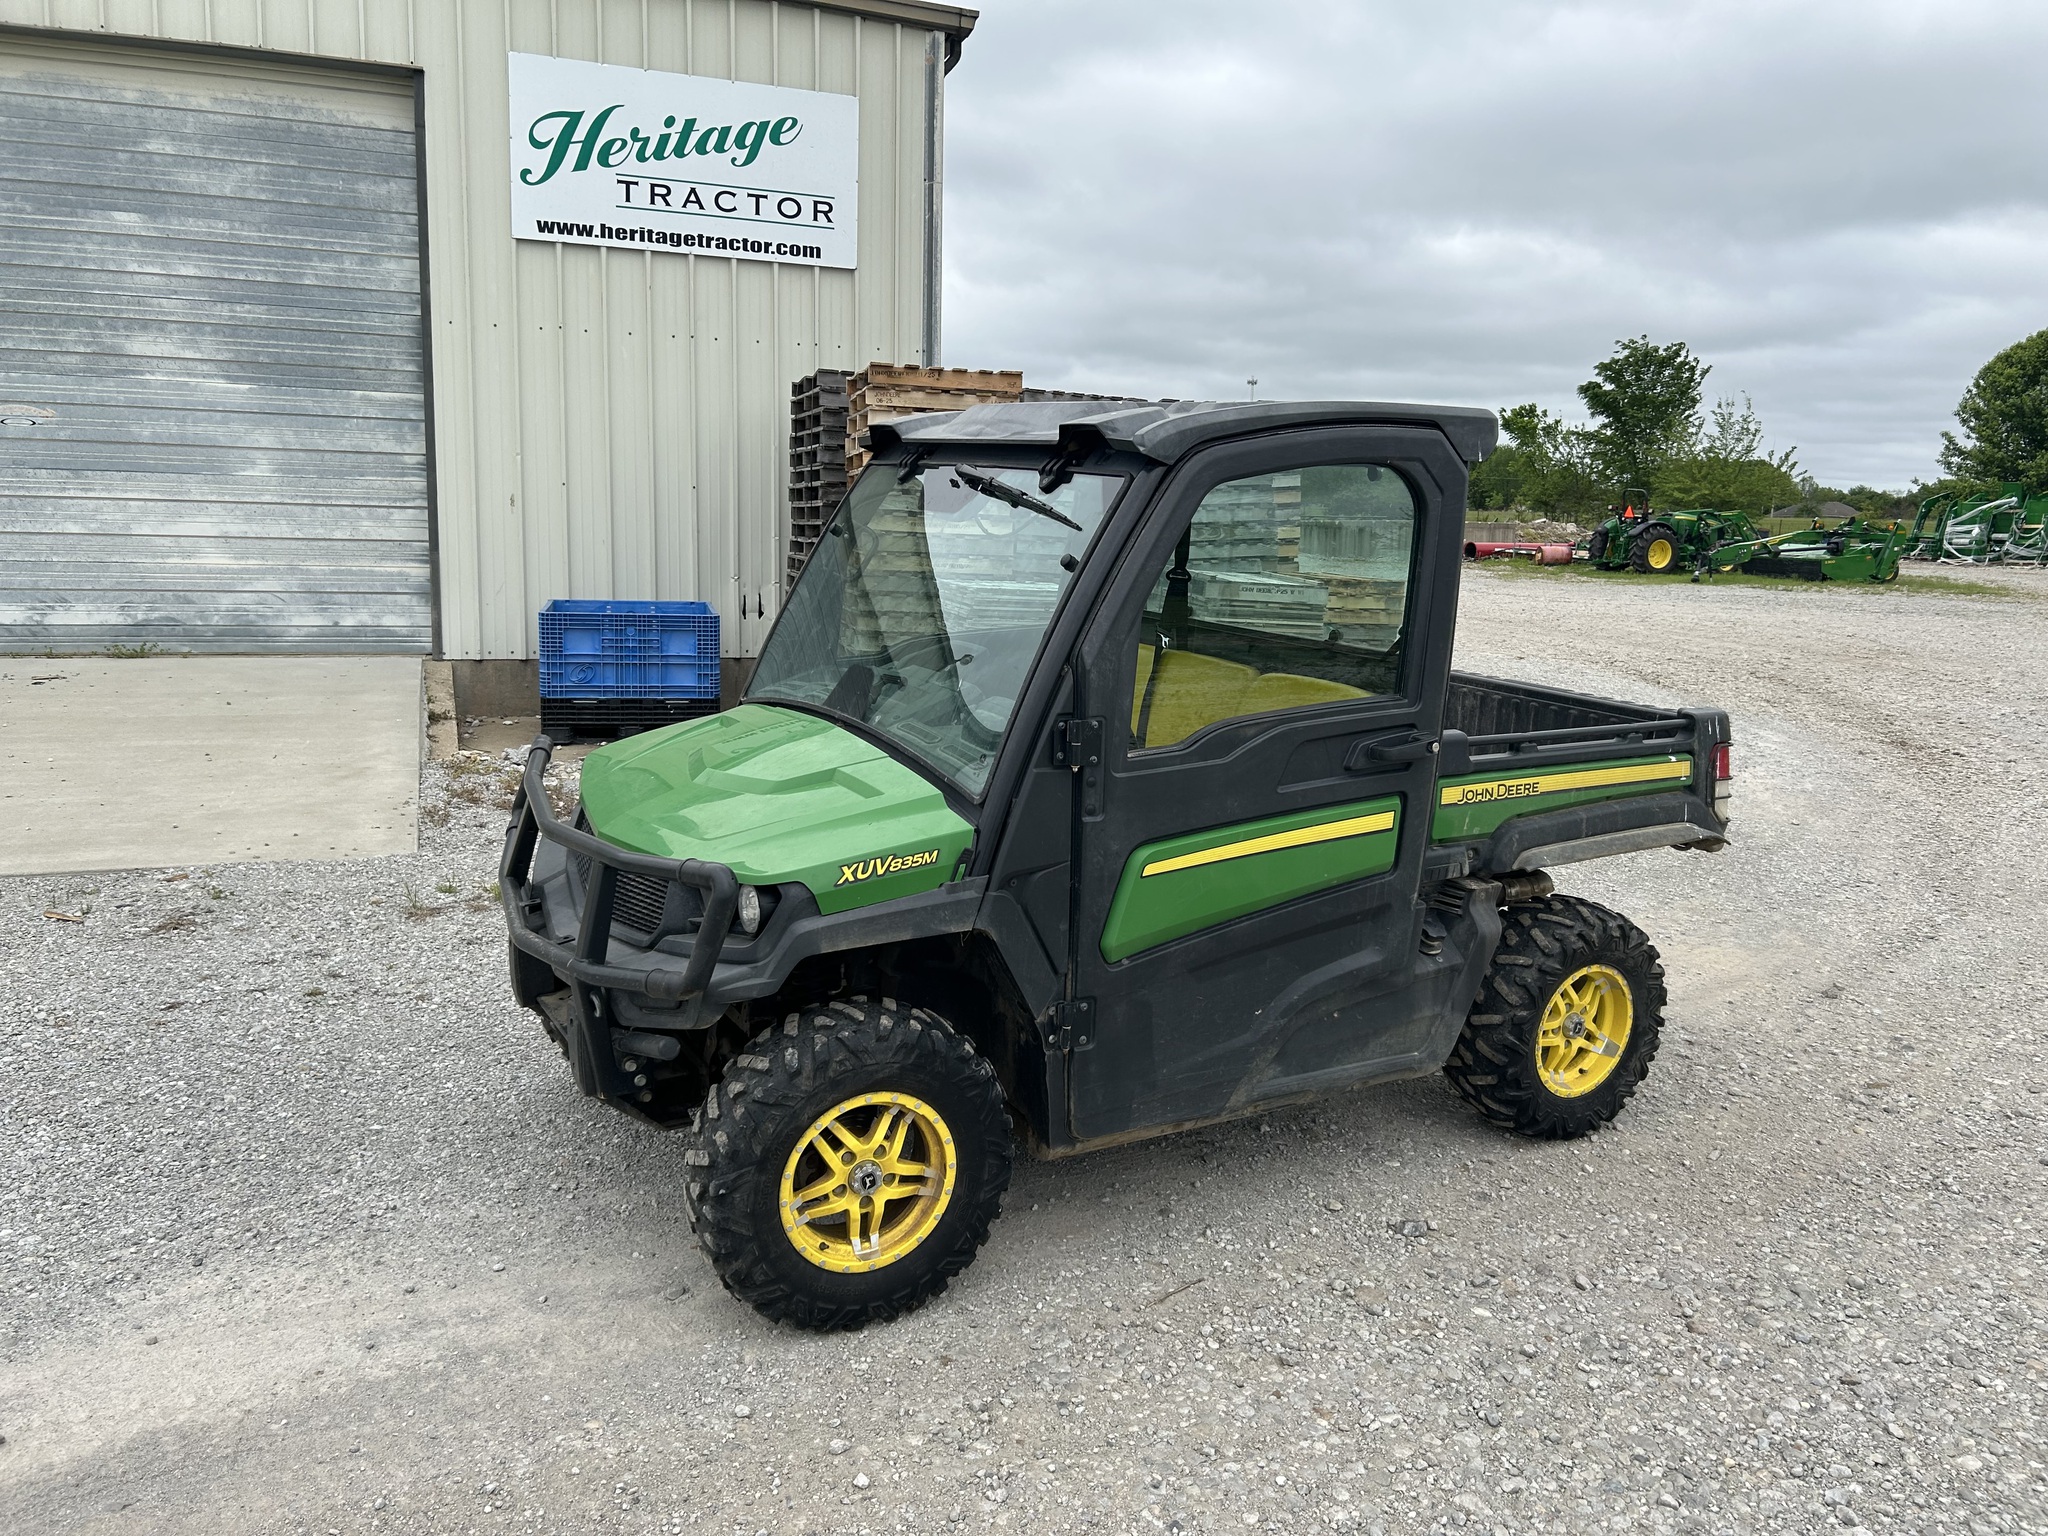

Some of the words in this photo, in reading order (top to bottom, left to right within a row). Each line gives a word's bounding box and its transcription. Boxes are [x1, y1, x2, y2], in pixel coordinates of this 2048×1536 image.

[519, 104, 803, 186] Heritage
[616, 179, 834, 223] TRACTOR
[536, 219, 822, 259] www.heritagetractor.com
[1457, 788, 1494, 804] JOHN
[1497, 781, 1540, 799] DEERE
[836, 849, 939, 886] XUV835M
